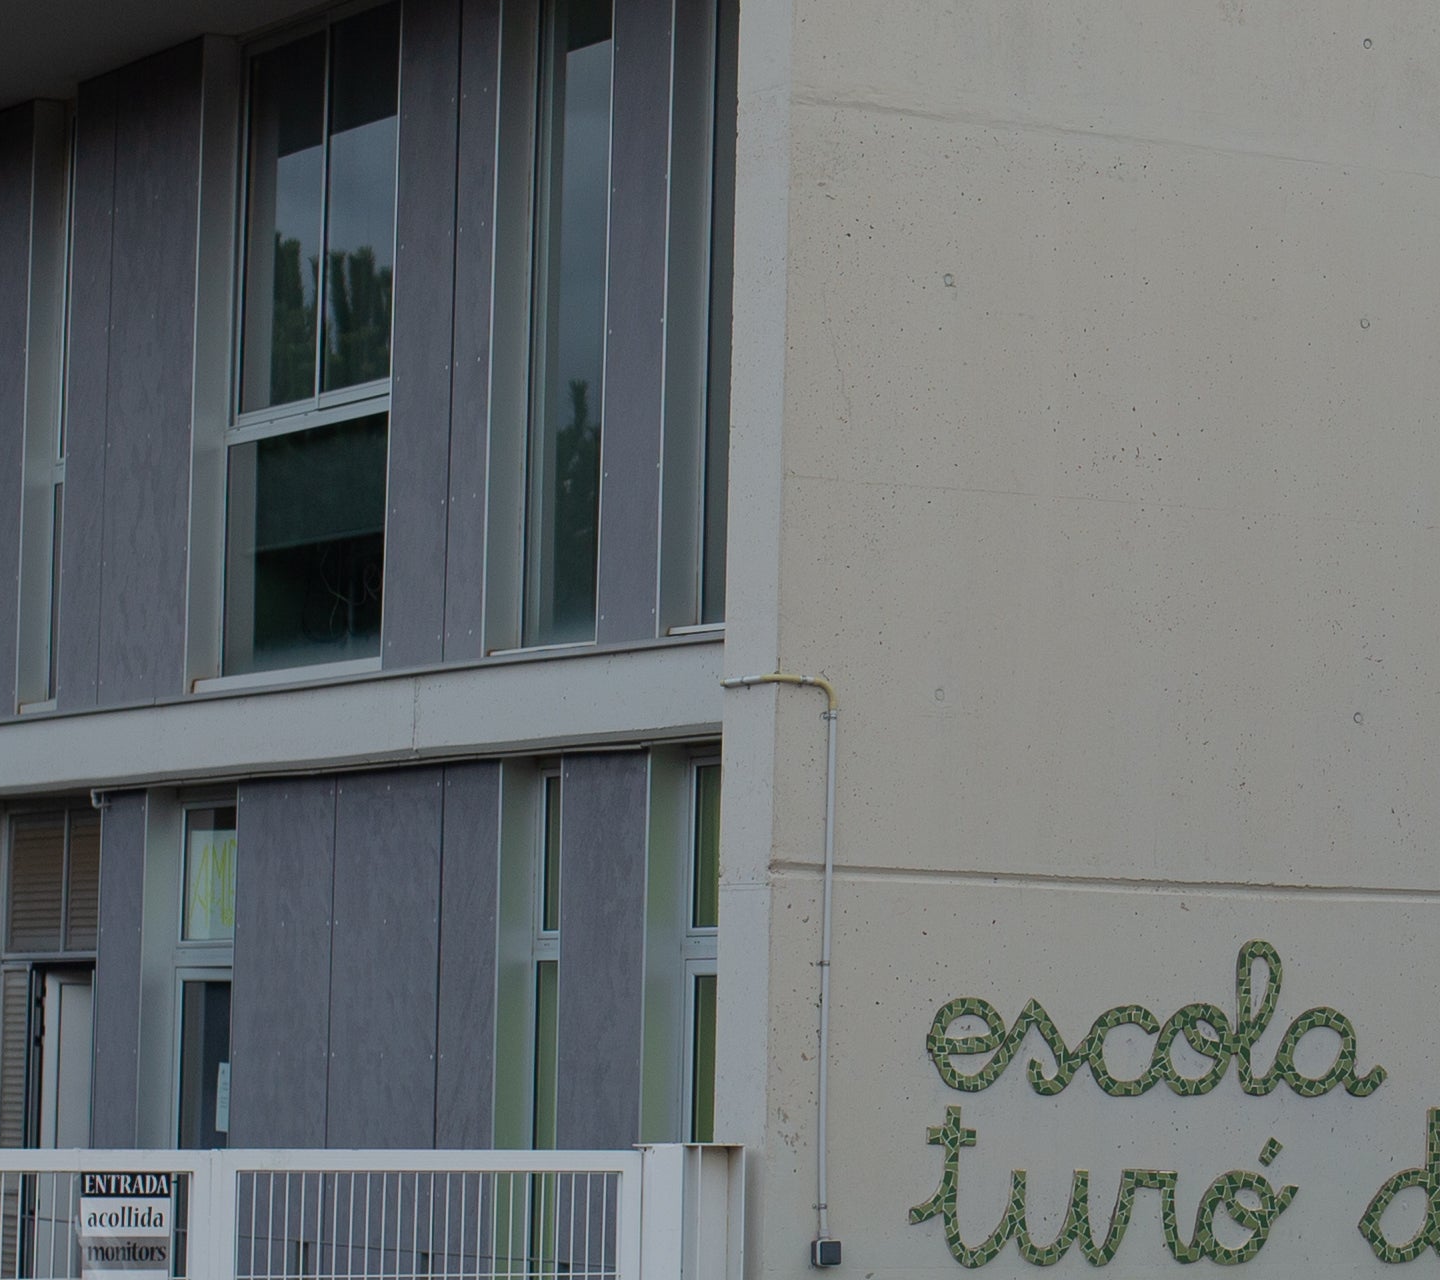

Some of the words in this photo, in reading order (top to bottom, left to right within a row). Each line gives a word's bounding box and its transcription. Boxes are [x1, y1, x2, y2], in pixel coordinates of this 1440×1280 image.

[925, 938, 1388, 1098] escola
[84, 1174, 169, 1195] ENTRADA
[909, 1106, 1299, 1268] turó
[88, 1206, 163, 1227] acollida
[88, 1241, 166, 1261] monitors
